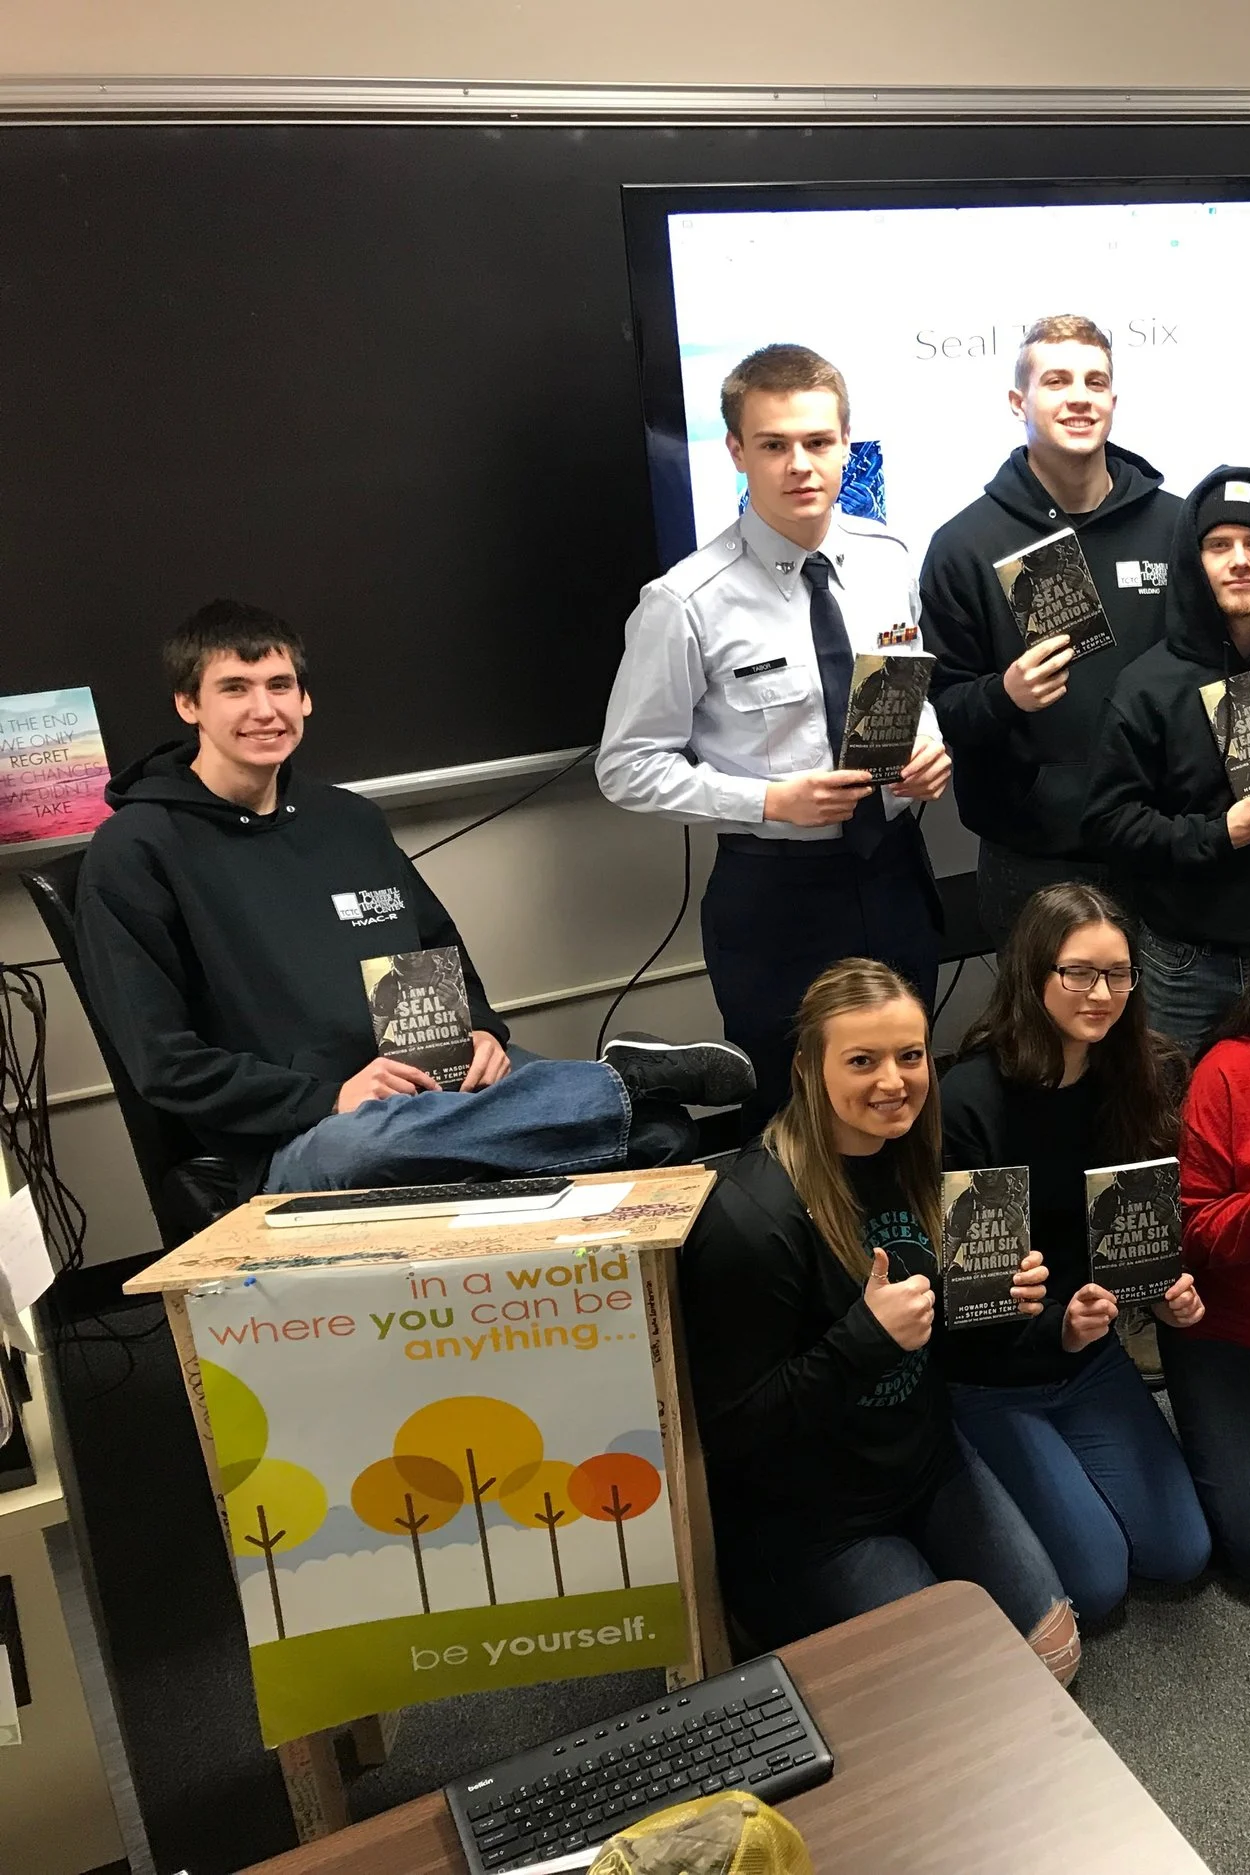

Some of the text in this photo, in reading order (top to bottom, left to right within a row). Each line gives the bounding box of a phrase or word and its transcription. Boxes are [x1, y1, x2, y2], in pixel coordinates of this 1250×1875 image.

[915, 325, 997, 360] Seal
[1128, 318, 1178, 348] Six
[1121, 576, 1139, 584] TCTC
[1033, 580, 1074, 608] SEAL
[1031, 589, 1086, 623] TEAM SIX
[1035, 602, 1090, 635] WARRIOR
[8, 717, 37, 733] THE
[43, 712, 78, 728] END
[30, 730, 74, 748] ONLY
[10, 748, 70, 769] REGRET
[21, 761, 104, 785] CHANCES
[33, 801, 73, 818] TAKE
[352, 914, 398, 926] HVAC-R
[399, 996, 445, 1018] SEAL
[391, 1010, 457, 1032] TEAM SIX
[394, 1025, 460, 1047] WARRIOR
[442, 1064, 470, 1073] WASDIN
[970, 1219, 1010, 1240] SEAL
[1115, 1211, 1159, 1232] SEAL
[962, 1236, 1018, 1255] TEAM SIX
[1105, 1224, 1169, 1246] TEAM SIX
[1107, 1240, 1169, 1261] WARRIOR
[963, 1253, 1018, 1272] WARRIOR
[406, 1253, 630, 1301] in a world
[208, 1287, 632, 1346] where you can be
[959, 1303, 988, 1312] HOWARD
[965, 1308, 997, 1318] STEPHEN
[404, 1319, 637, 1362] anything...
[411, 1615, 657, 1672] be yourself.
[468, 1778, 494, 1792] belkin
